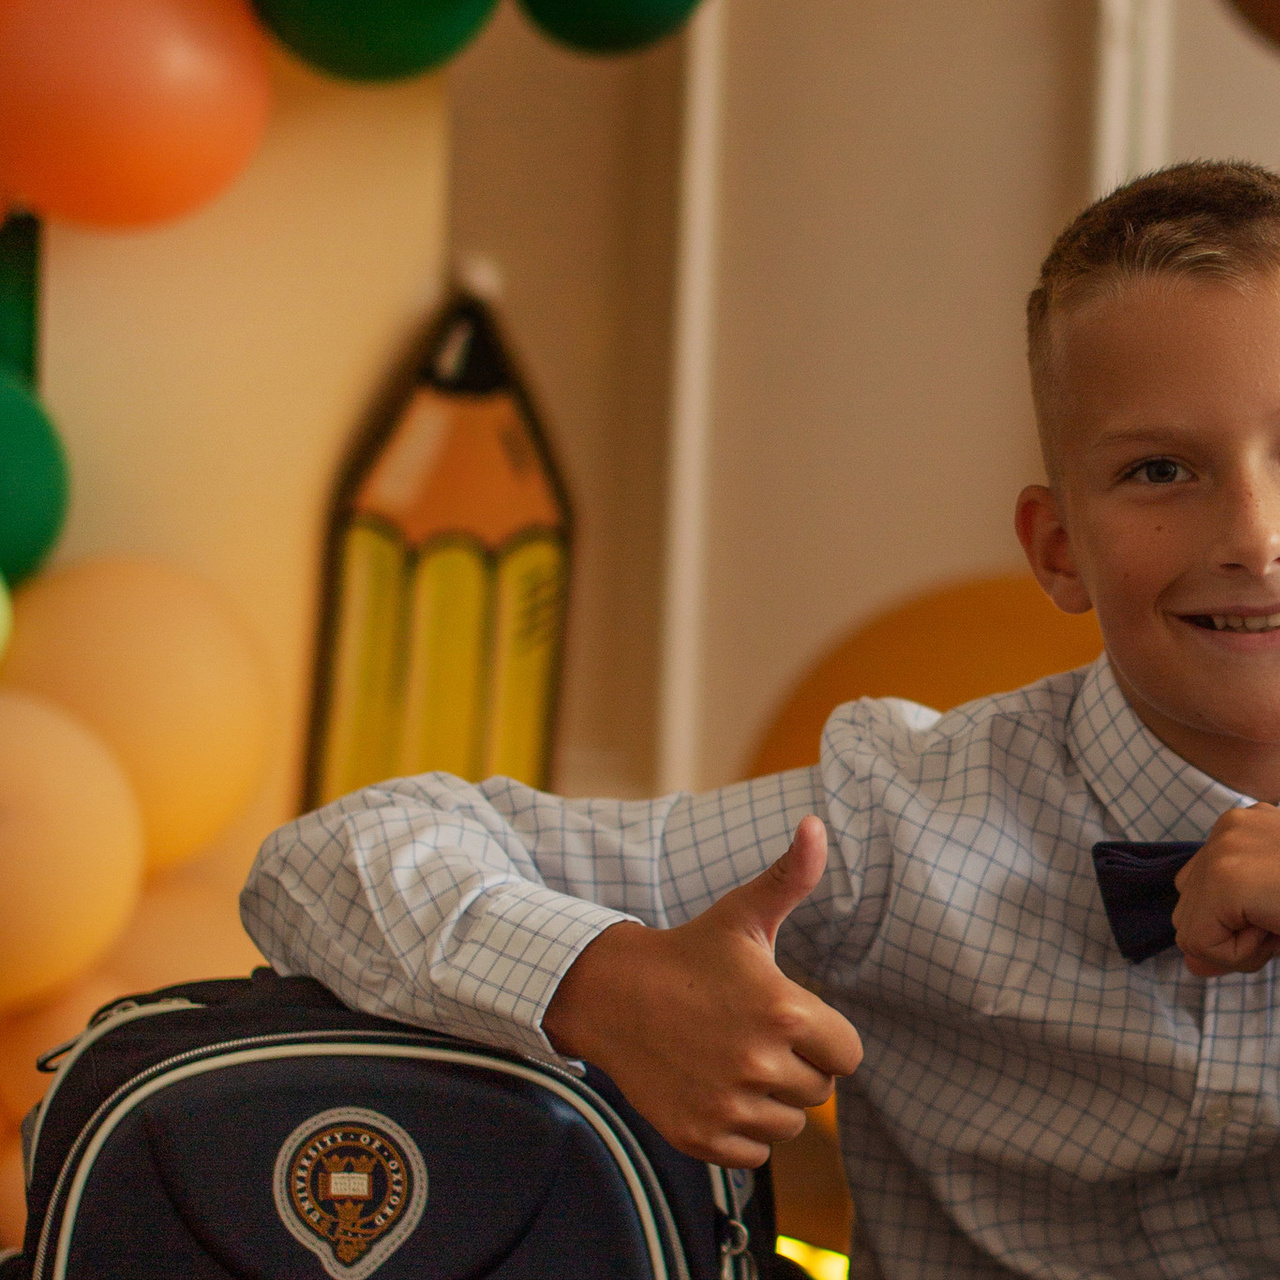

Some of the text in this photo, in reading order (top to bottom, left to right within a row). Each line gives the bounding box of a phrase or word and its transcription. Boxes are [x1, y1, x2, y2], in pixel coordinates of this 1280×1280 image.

[296, 1131, 403, 1226] UNIVERSITY OF OXFORD
